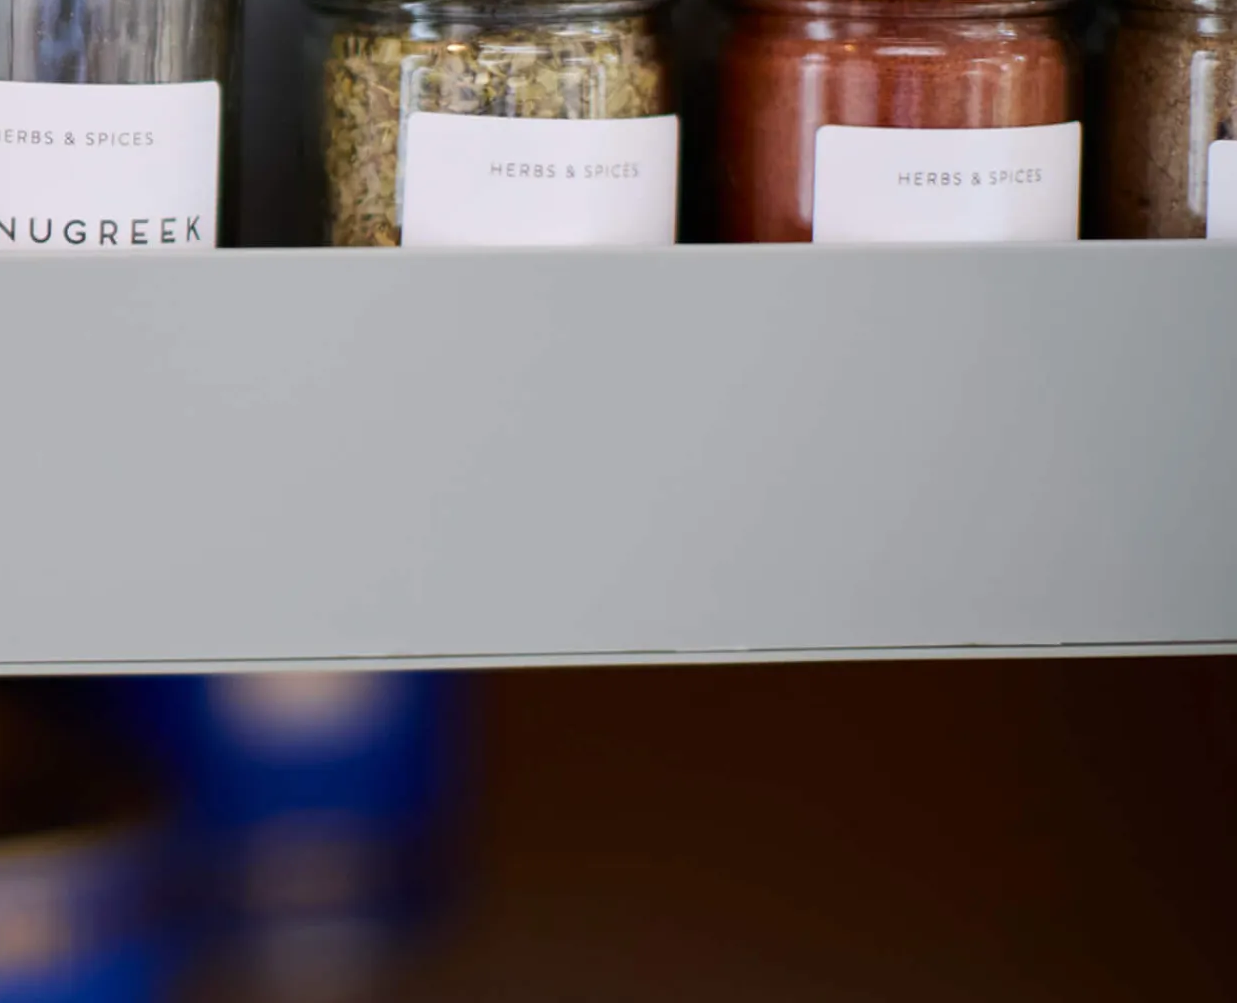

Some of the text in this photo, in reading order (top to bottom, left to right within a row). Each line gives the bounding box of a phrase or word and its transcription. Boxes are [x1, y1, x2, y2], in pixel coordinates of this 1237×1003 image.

[63, 131, 76, 146] &
[85, 131, 154, 147] SPICES
[490, 161, 640, 179] HERBS & SPICES
[897, 168, 1043, 187] HERBS & SPICES
